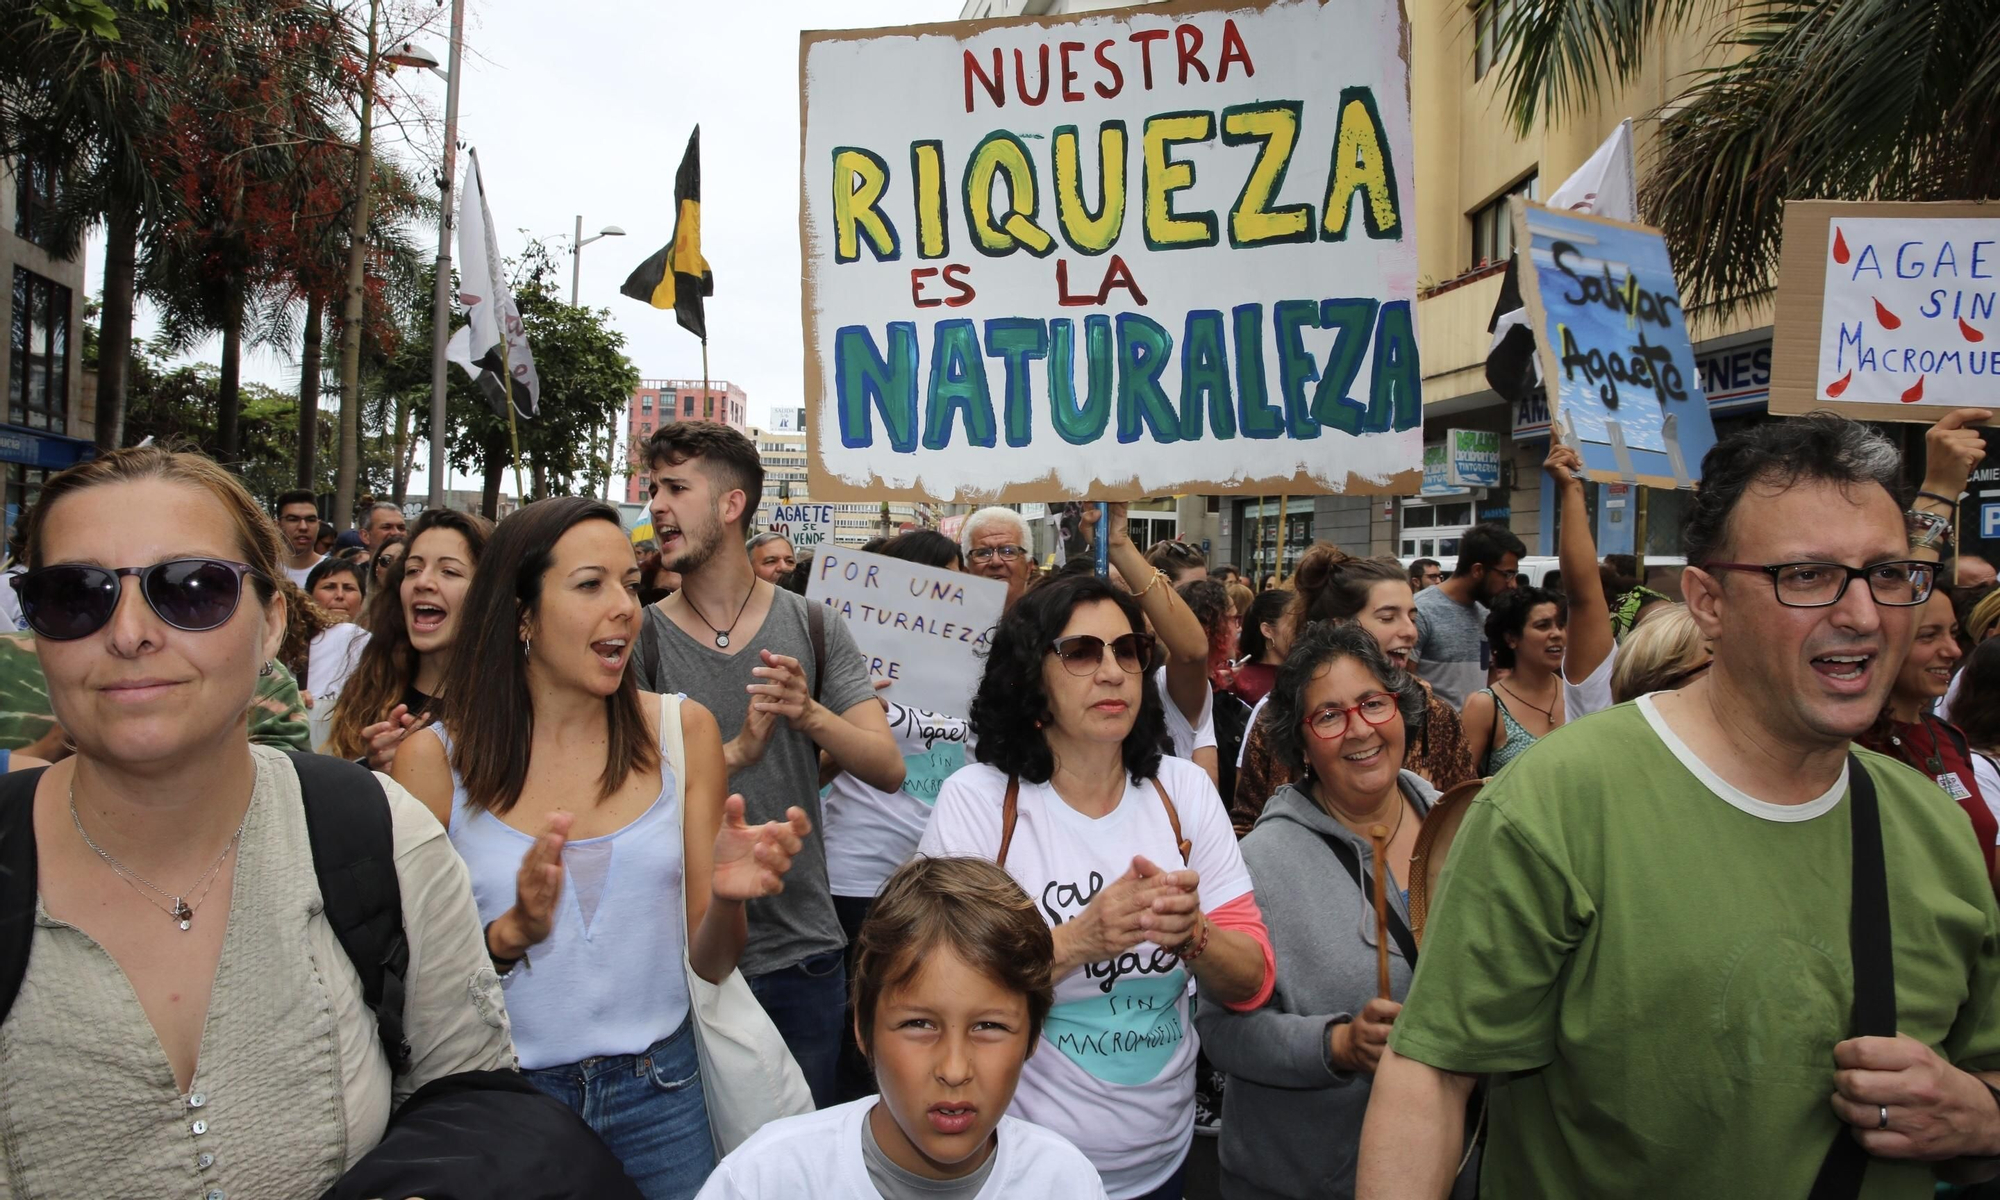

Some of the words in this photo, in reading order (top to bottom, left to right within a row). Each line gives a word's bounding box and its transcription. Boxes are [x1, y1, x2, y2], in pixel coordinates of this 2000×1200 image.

[963, 19, 1255, 113] NUESTRA
[832, 86, 1402, 263] RIQUEZA
[912, 264, 975, 307] ES
[1057, 254, 1148, 307] LA
[1551, 241, 1681, 328] Salvar
[1852, 241, 1996, 281] AGAE
[1920, 289, 1996, 319] SIN
[835, 298, 1422, 454] NATURALEZA
[1560, 326, 1688, 410] Agaete
[775, 505, 834, 523] AGAETE
[802, 523, 817, 531] SE
[821, 555, 880, 589] POR
[909, 577, 965, 606] UNA
